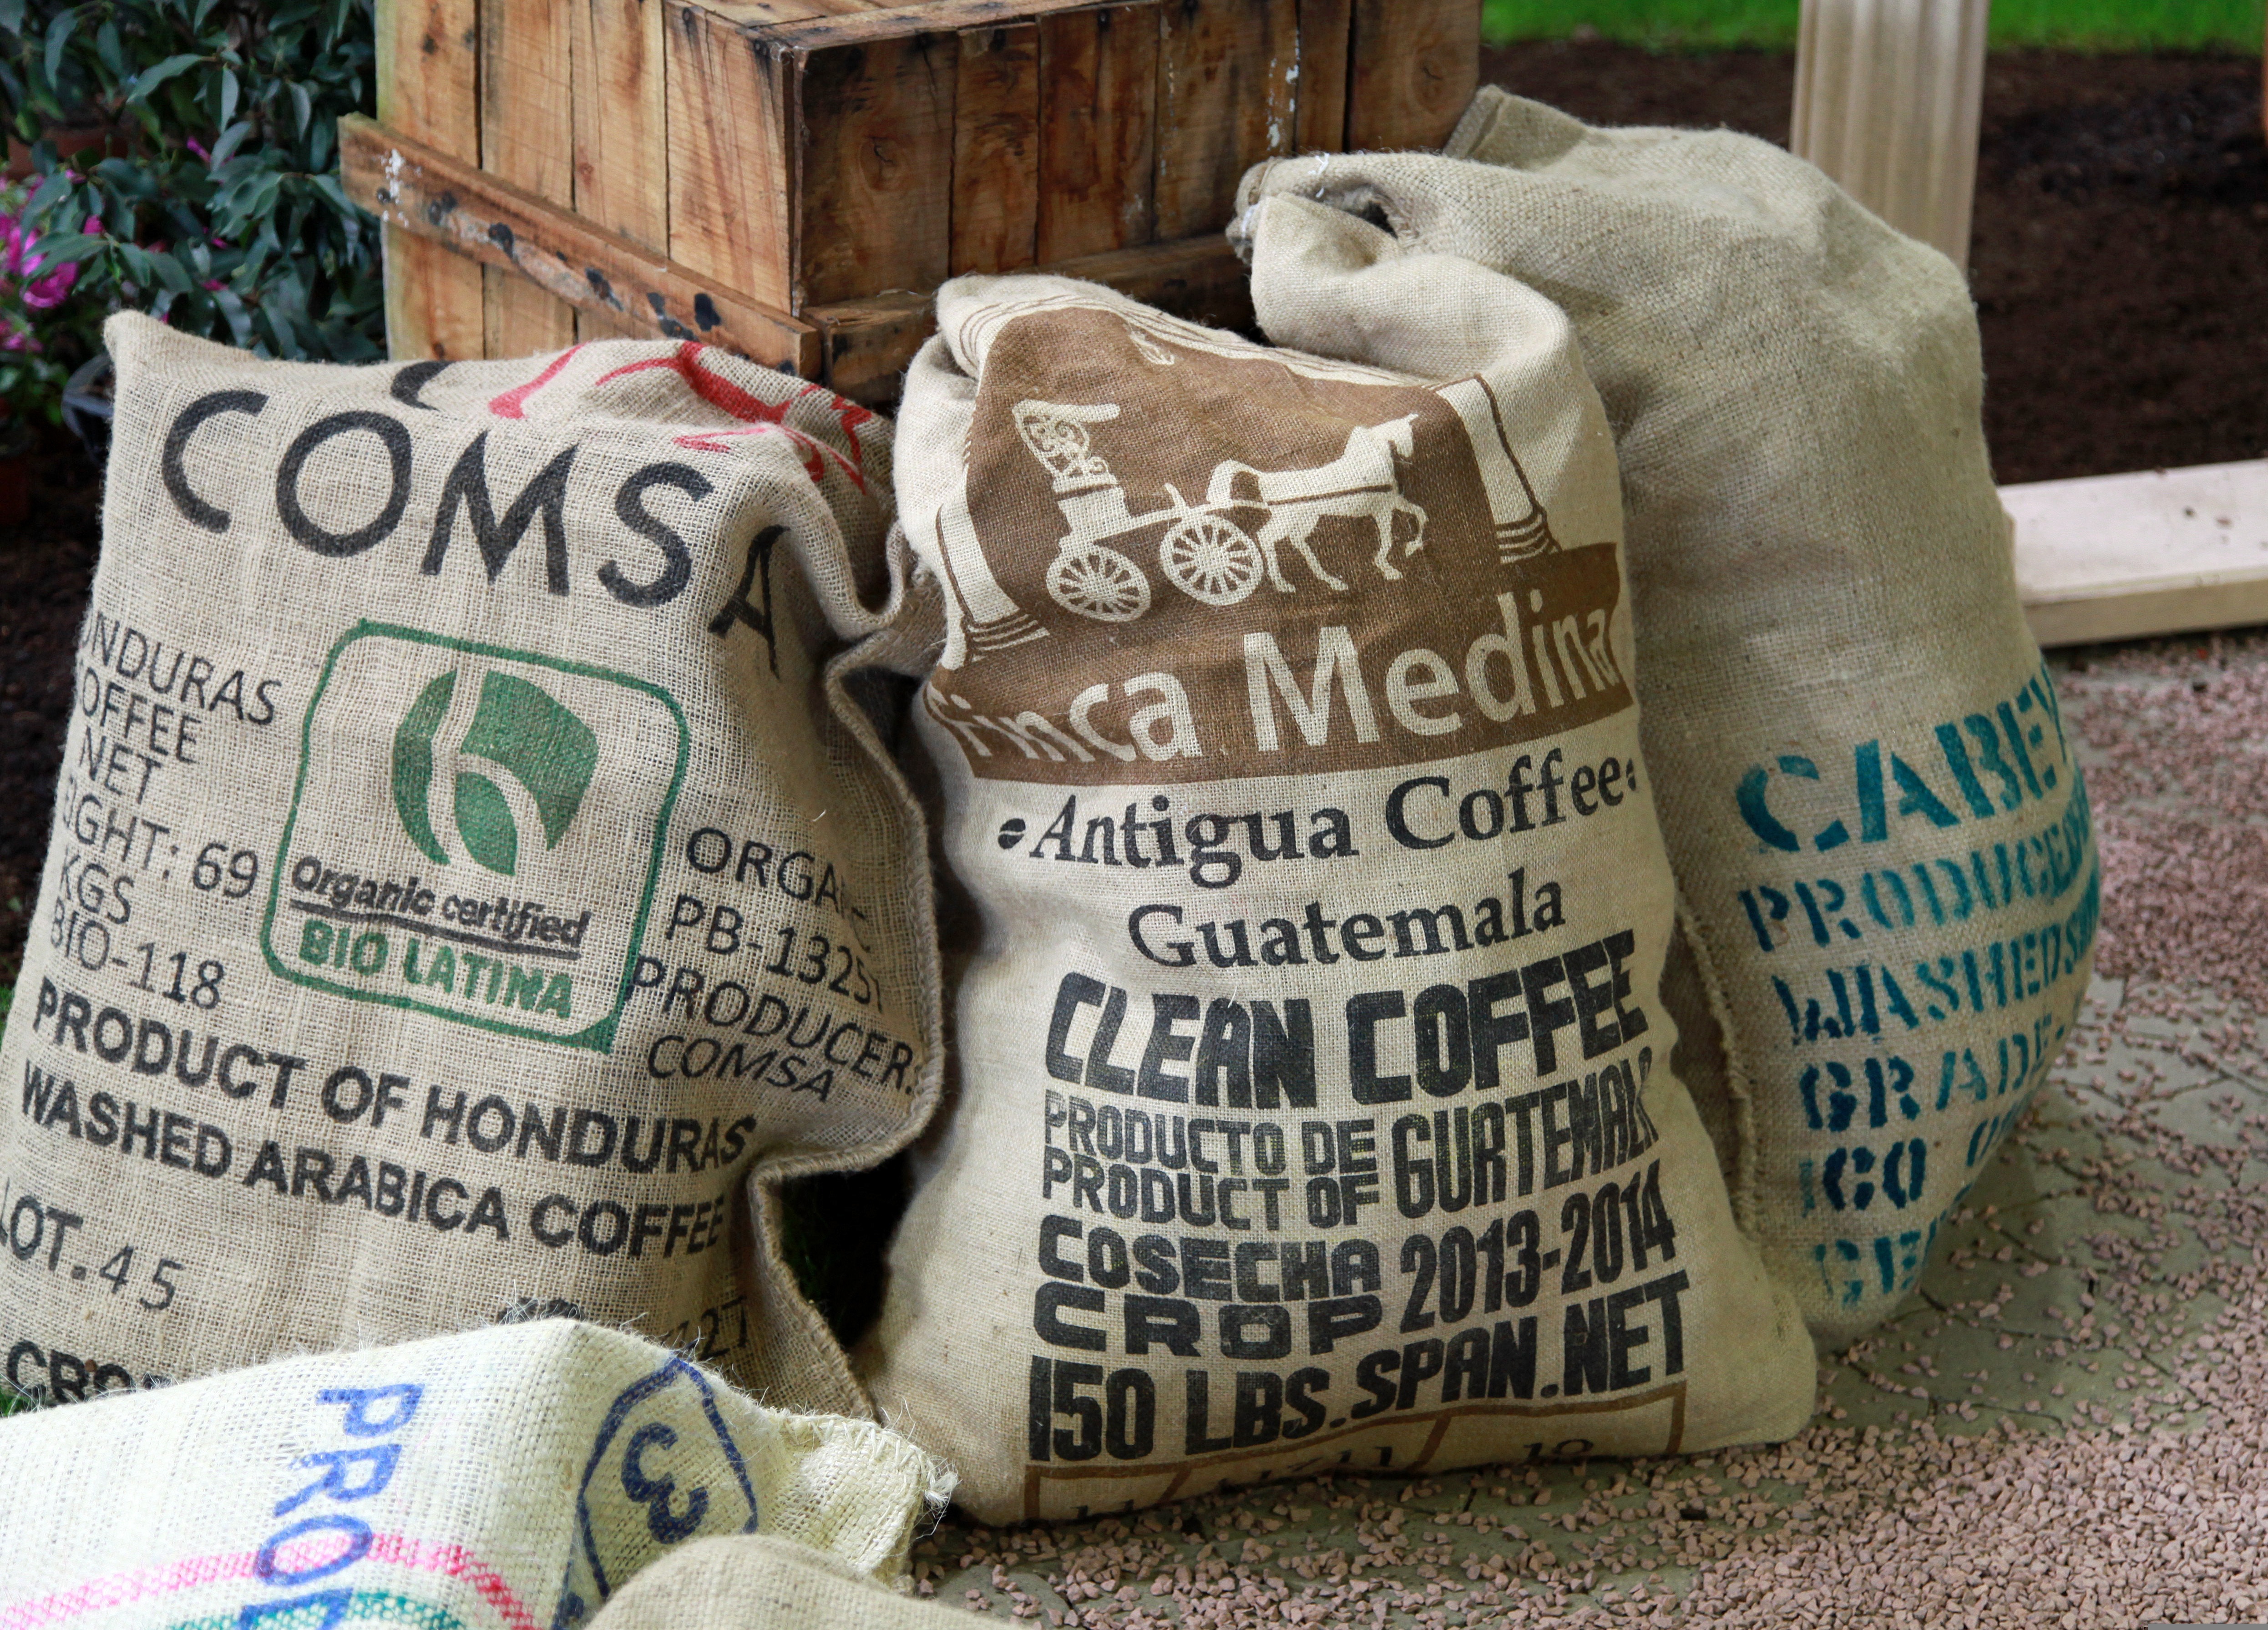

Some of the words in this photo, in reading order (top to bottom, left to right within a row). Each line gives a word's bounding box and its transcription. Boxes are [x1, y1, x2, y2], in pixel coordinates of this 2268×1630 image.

[162, 390, 790, 679] COMSA
[78, 660, 202, 764] OFFEE
[1243, 588, 1620, 752] Medina
[79, 727, 161, 804] NET
[65, 775, 179, 879] IGHT:
[193, 841, 258, 899] 69
[1029, 794, 1359, 889] Antigua
[1386, 748, 1623, 850] Coffee
[60, 844, 134, 926] KGS
[292, 855, 435, 915] Organic
[443, 895, 592, 948] certified
[1129, 867, 1565, 967] Guatemala
[50, 897, 225, 1010] BIO-118
[299, 920, 388, 976] BIO
[404, 938, 572, 1019] LATINA
[648, 1035, 835, 1103] COMSA
[1045, 972, 1317, 1109] CLEAN
[1346, 929, 1649, 1105] COFFEE
[33, 976, 310, 1109] PRODUCT
[322, 1066, 410, 1127] OF
[420, 1084, 757, 1174] HONDURAS
[22, 1059, 232, 1178] WASHED
[242, 1140, 509, 1241] ARABICA
[530, 1193, 725, 1260] COFFEE
[1045, 1089, 1286, 1175] PRODUCTO
[1301, 1119, 1376, 1175] DE
[1043, 1145, 1290, 1231] PRODUCT
[1307, 1173, 1380, 1228] OF
[1038, 1214, 1382, 1302] COSECHA
[1399, 1158, 1676, 1333] 2013-2014
[7, 1339, 173, 1404] CRO
[1033, 1281, 1383, 1360] CROP
[1028, 1355, 1155, 1462] 150
